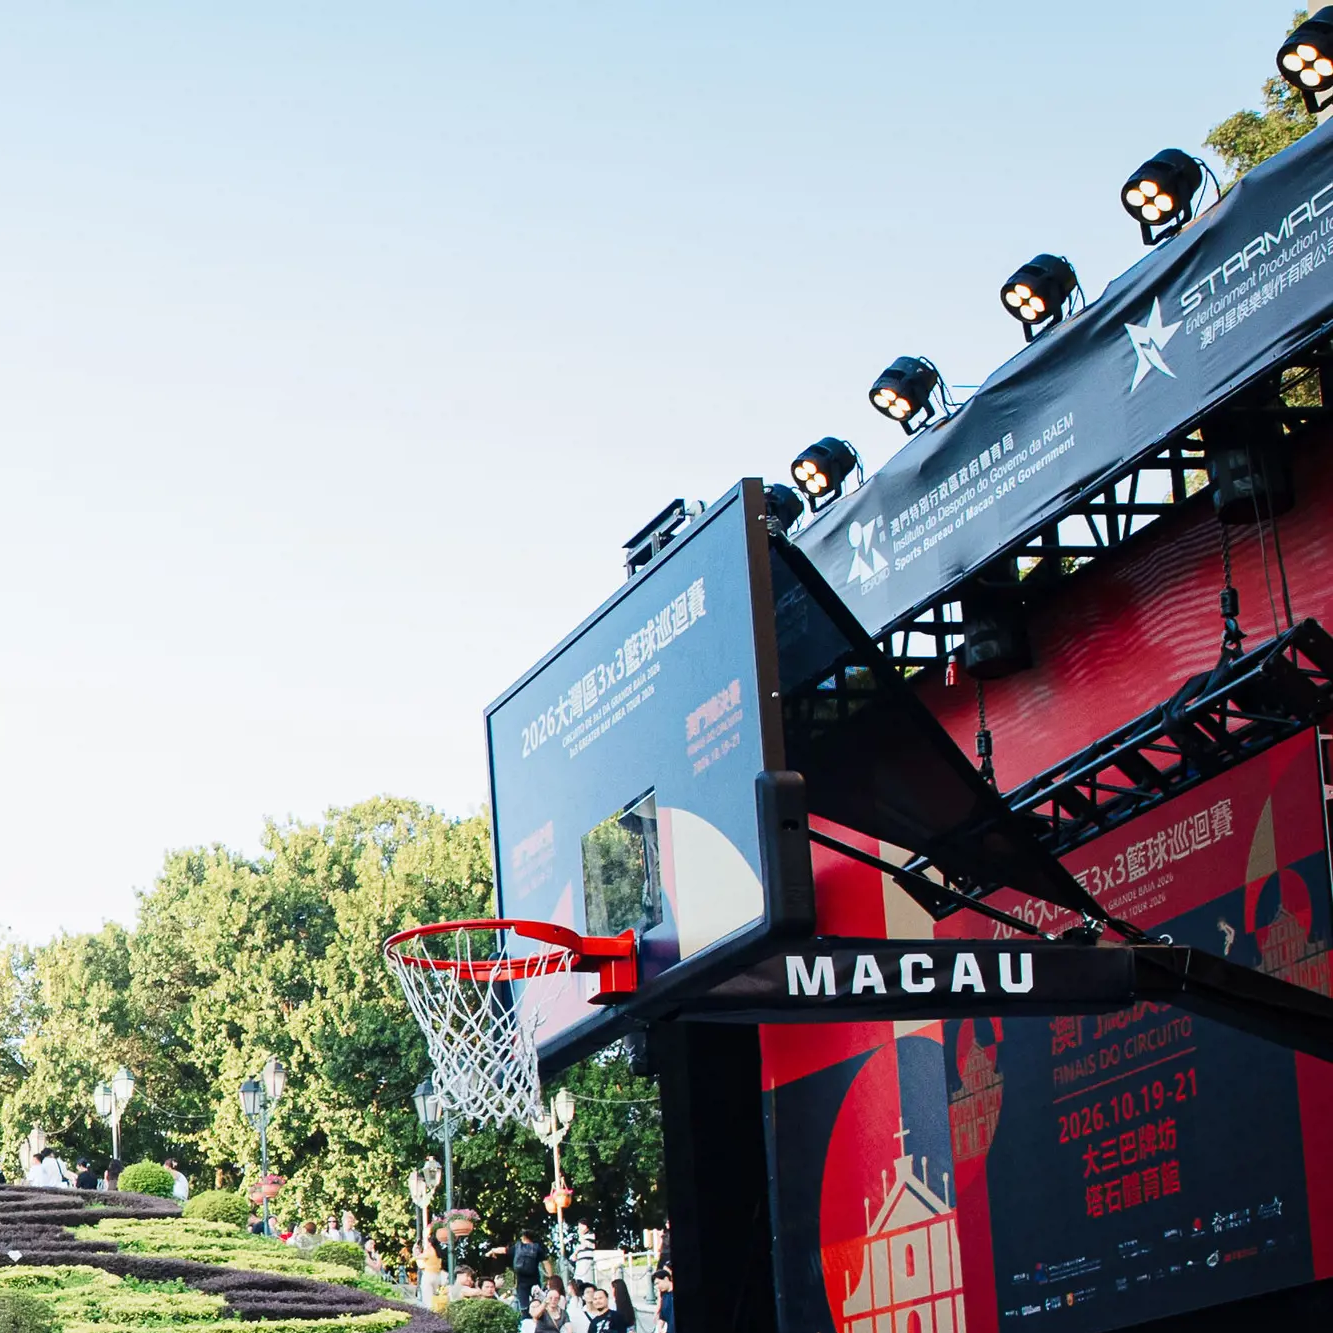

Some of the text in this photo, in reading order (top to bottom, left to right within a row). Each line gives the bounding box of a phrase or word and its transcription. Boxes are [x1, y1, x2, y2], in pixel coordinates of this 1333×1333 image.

[1186, 272, 1257, 335] Entertainment
[1259, 229, 1317, 281] Production
[893, 523, 924, 553] Instituto
[925, 514, 937, 529] do
[937, 488, 975, 523] Desporto
[976, 478, 988, 493] do
[1029, 439, 1040, 454] da
[1042, 412, 1074, 447] RAEM
[894, 434, 1076, 572] Sports Bureau of Macao SAR Government
[786, 953, 1034, 996] MACAU
[1053, 1053, 1096, 1088] FINAIS
[1099, 1044, 1120, 1070] DO
[1124, 1015, 1193, 1060] CIRCUITO
[1058, 1068, 1198, 1145] 2026.10.19-21
[1083, 1116, 1177, 1179] 大三巴牌坊
[1085, 1160, 1181, 1219] 塔石體育館
